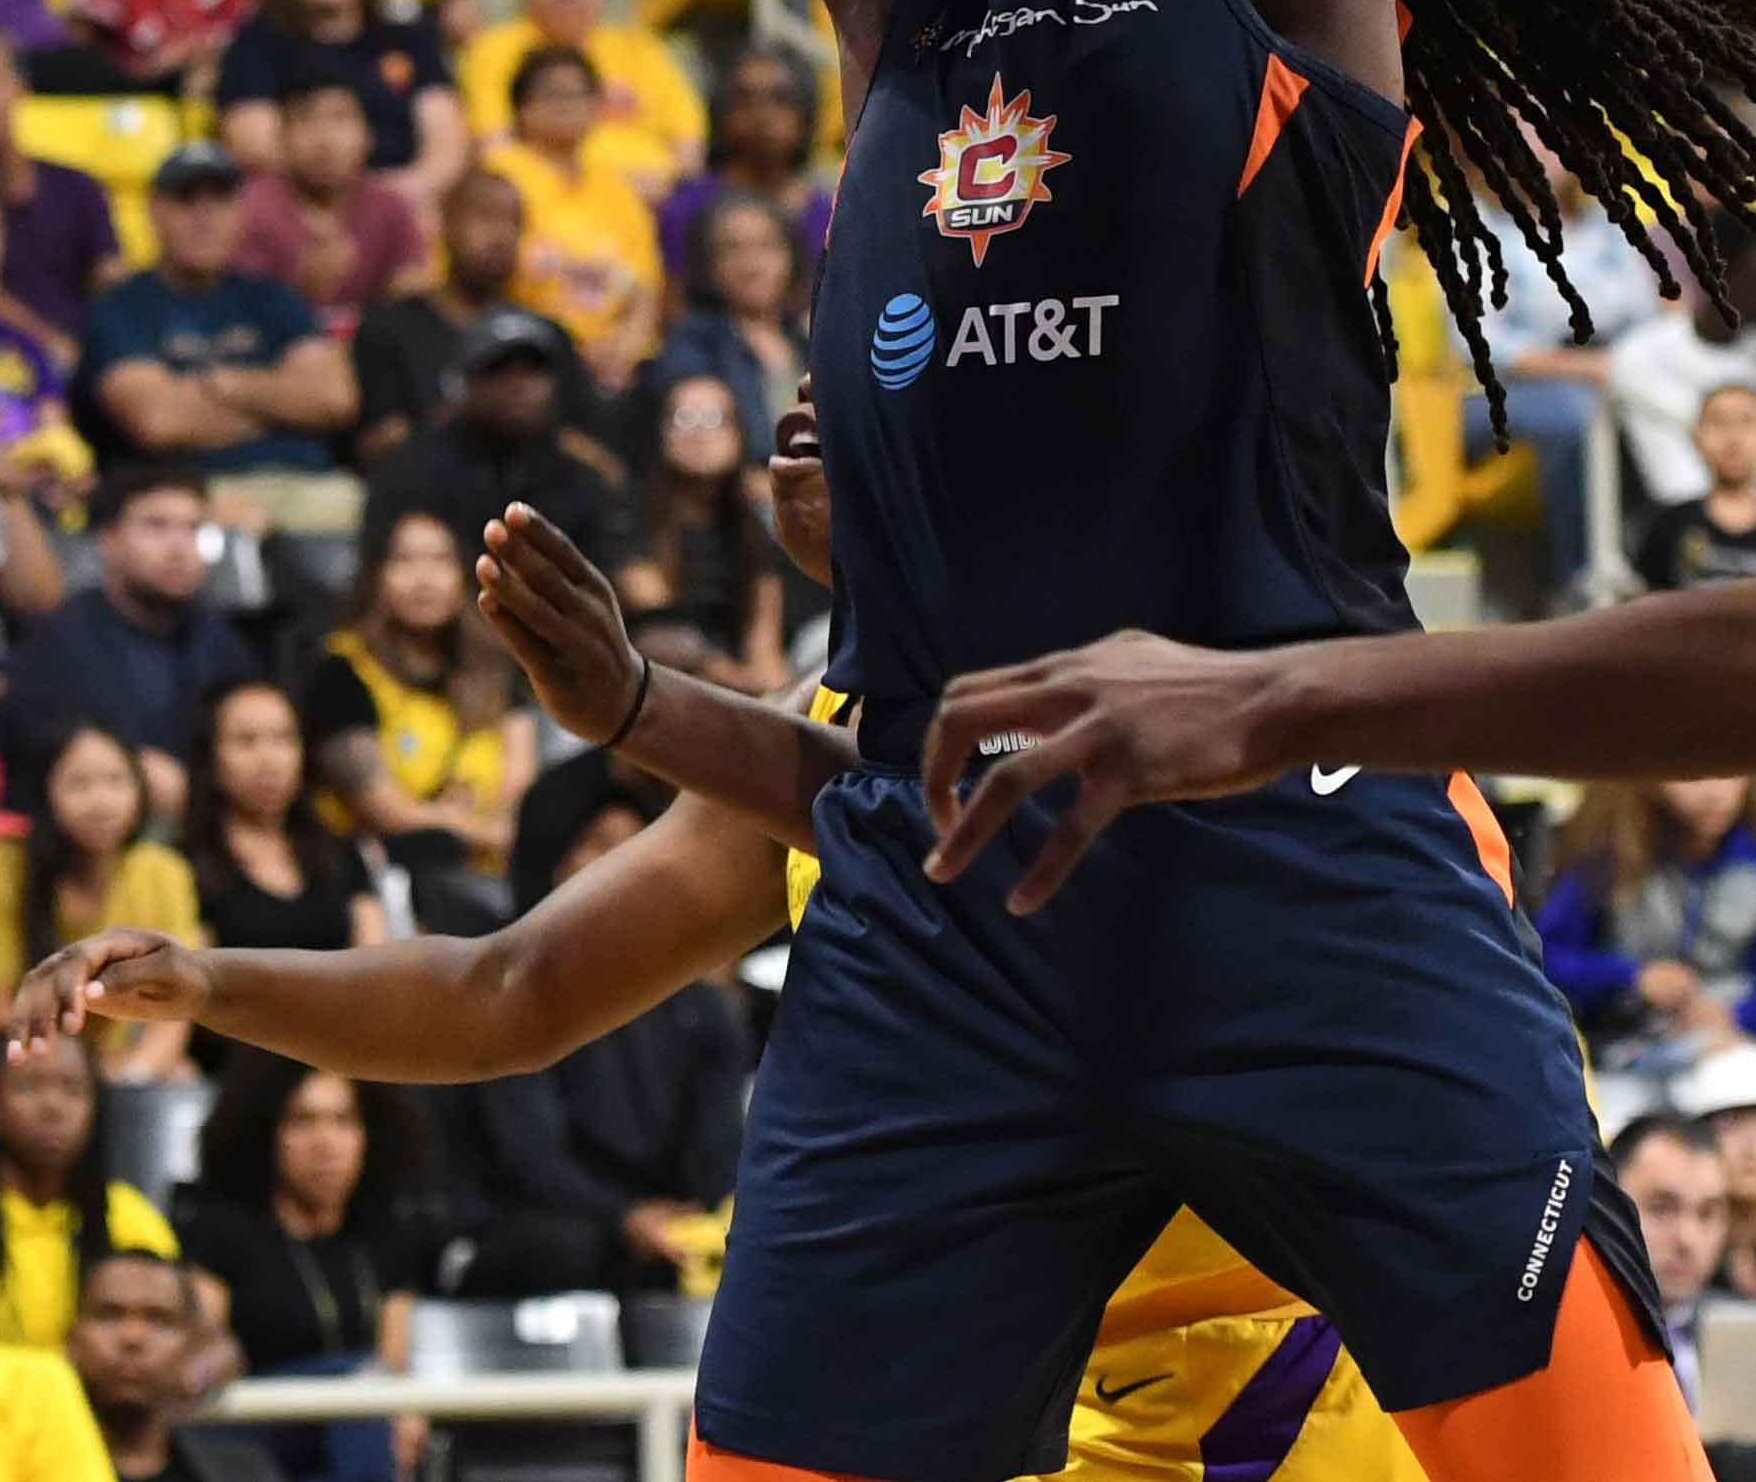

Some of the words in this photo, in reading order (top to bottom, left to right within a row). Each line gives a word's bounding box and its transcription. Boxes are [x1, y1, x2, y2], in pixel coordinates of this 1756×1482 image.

[956, 134, 1019, 202] C
[950, 204, 1014, 229] SUN
[946, 294, 1120, 367] AT&T
[1516, 1158, 1574, 1302] CONNECTICUT
